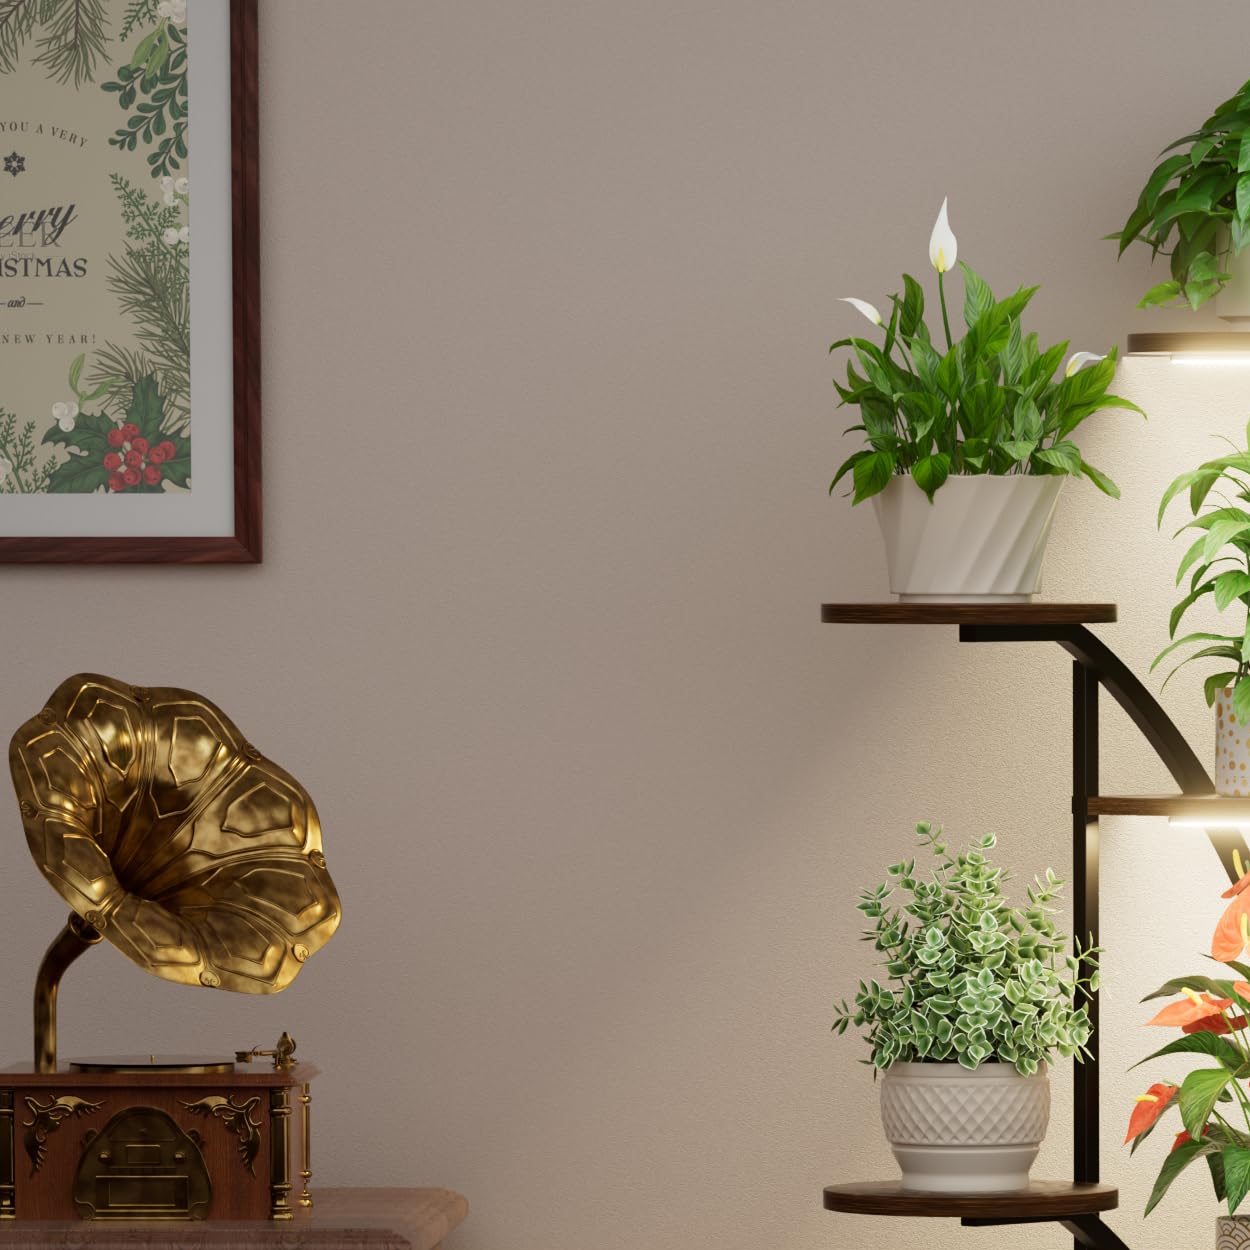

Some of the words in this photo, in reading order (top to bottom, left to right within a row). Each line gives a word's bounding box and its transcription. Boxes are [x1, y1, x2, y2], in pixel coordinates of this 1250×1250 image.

[0, 121, 29, 133] YOU
[35, 123, 43, 134] A
[51, 125, 89, 148] VERY
[7, 296, 26, 308] and
[2, 334, 36, 344] NEW
[46, 334, 96, 344] YEAR!
